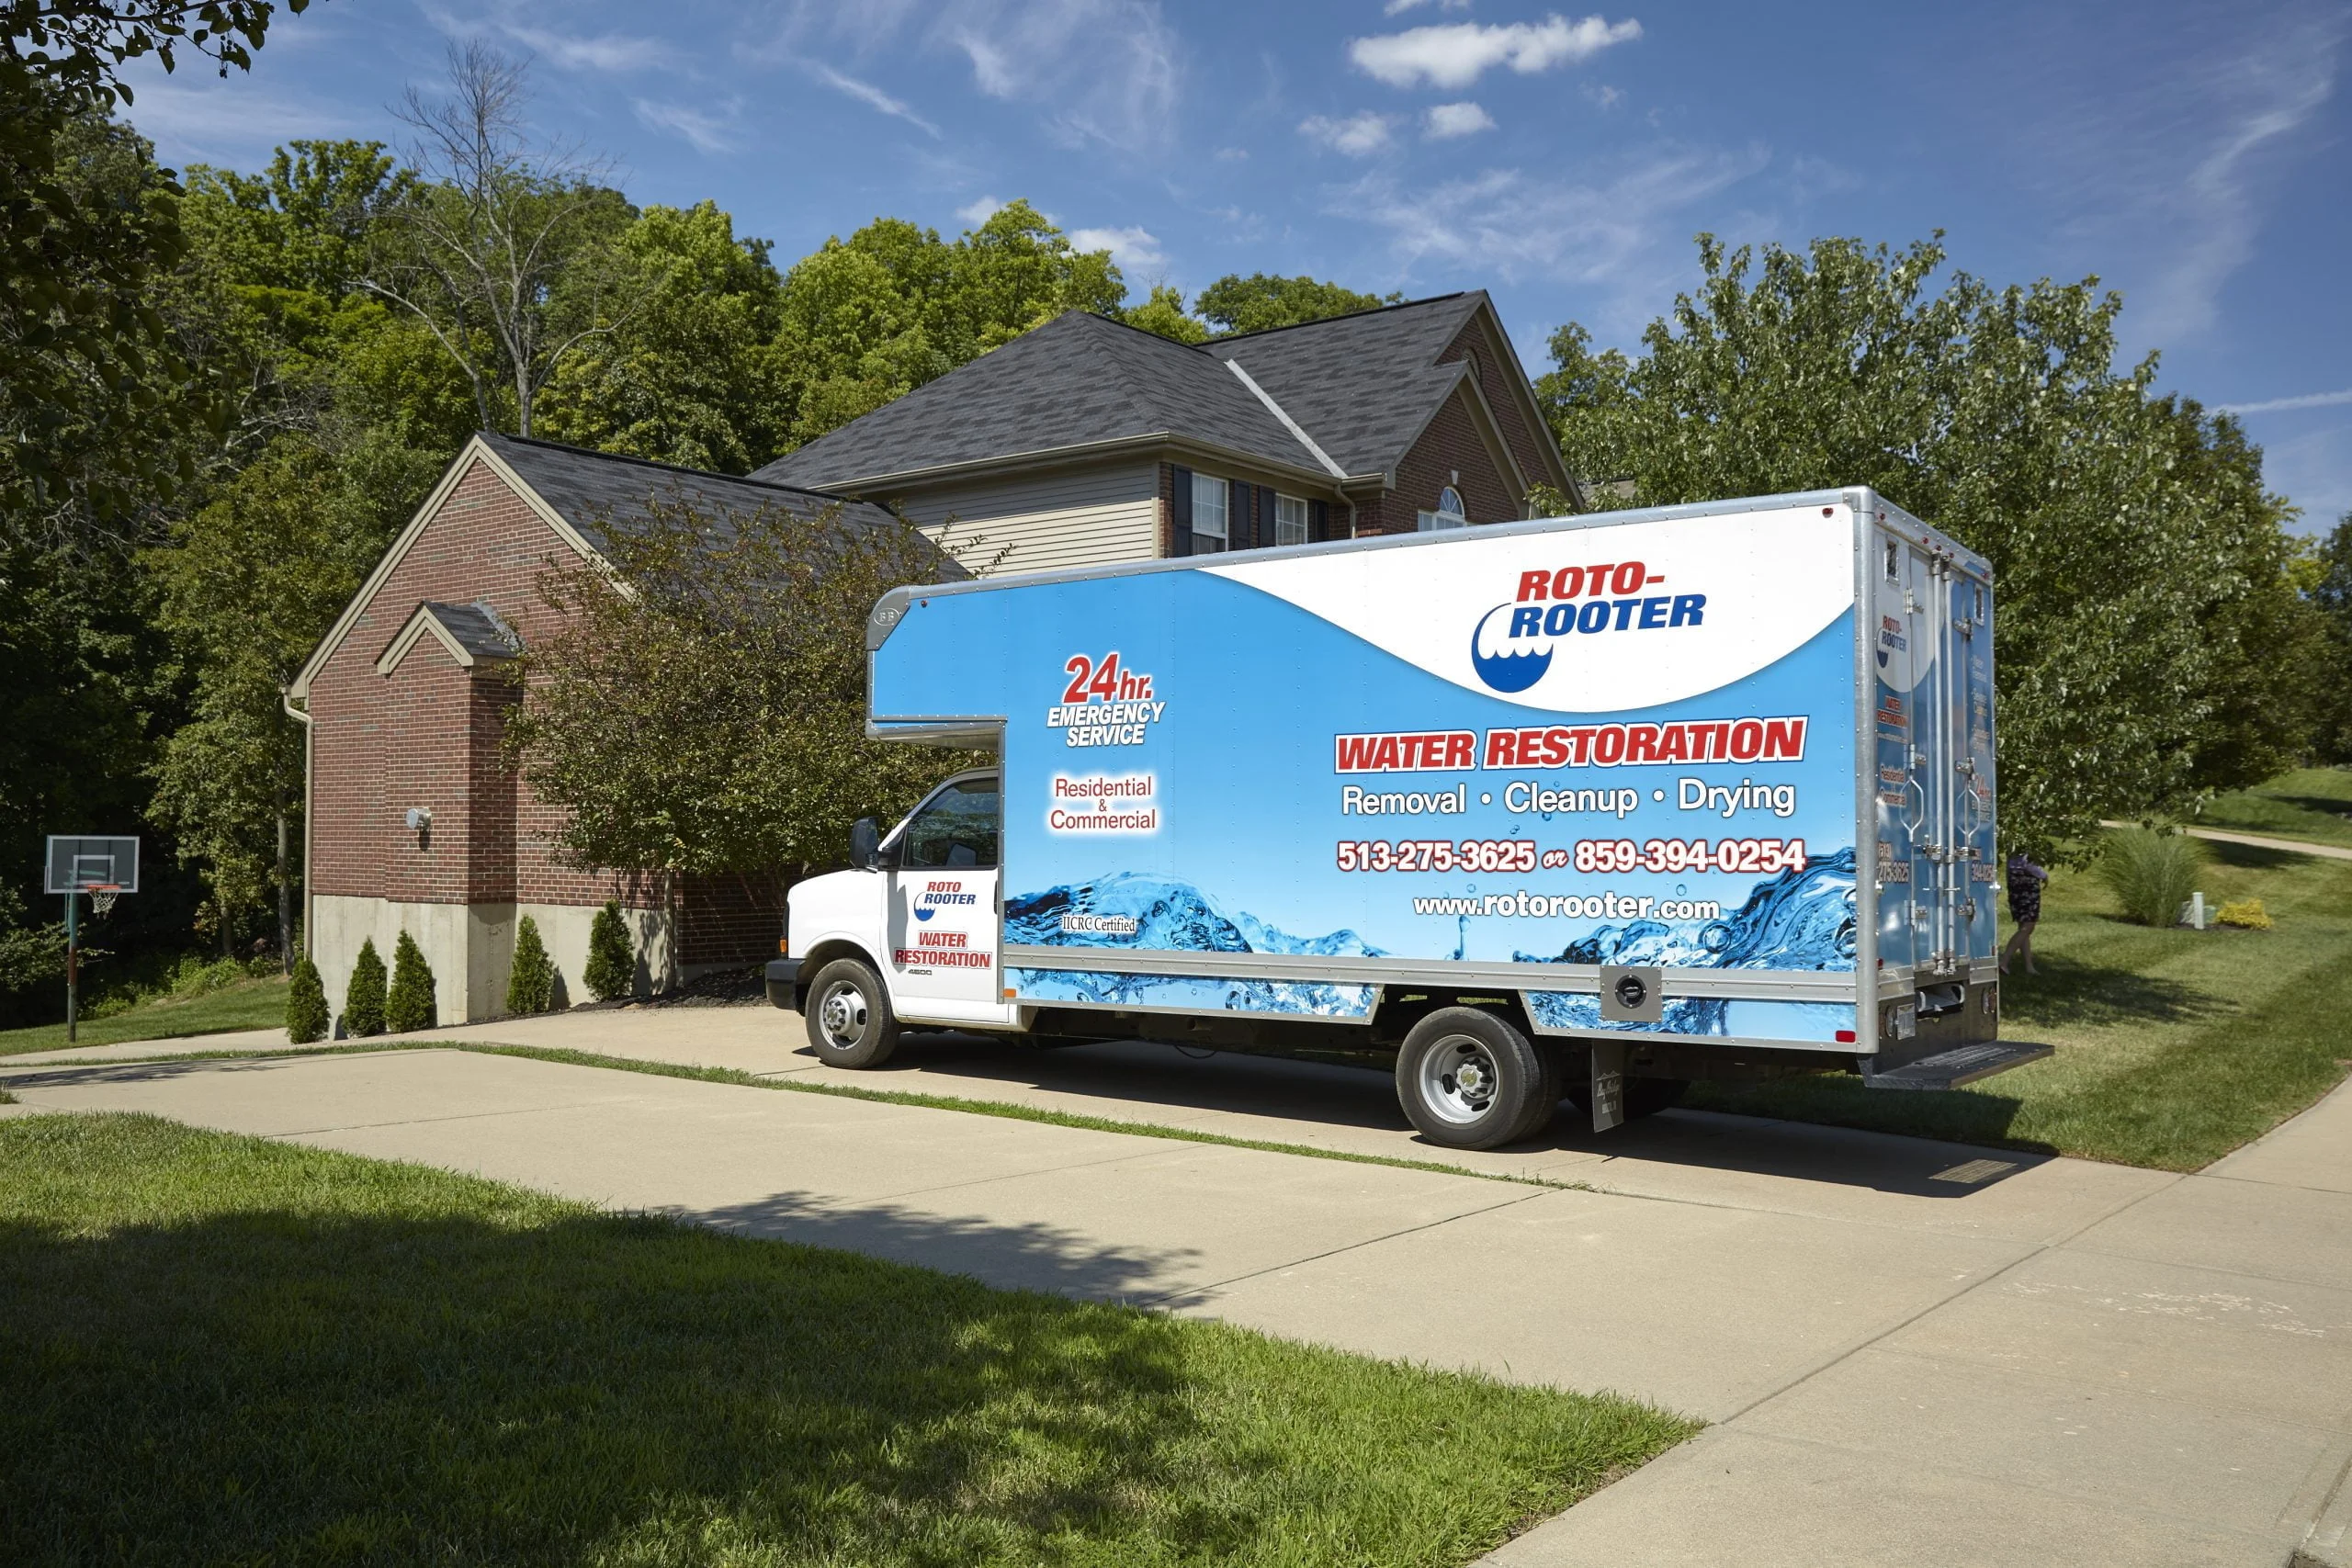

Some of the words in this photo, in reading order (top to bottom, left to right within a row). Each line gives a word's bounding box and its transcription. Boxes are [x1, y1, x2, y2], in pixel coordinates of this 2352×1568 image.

[1516, 560, 1665, 602] ROTO-
[1509, 593, 1707, 638] ROOTER
[1881, 630, 1907, 653] ROOTER
[1046, 701, 1166, 728] EMERGENCY
[1066, 724, 1146, 747] SERVICE
[1337, 732, 1475, 773] WATER
[1485, 719, 1804, 768] RESTORATION
[1056, 776, 1151, 797] Residential
[1098, 798, 1108, 812] &
[1341, 784, 1466, 816] Removal
[1504, 783, 1638, 818] Cleanup
[1678, 778, 1796, 818] Drying
[1050, 809, 1156, 829] Commercial
[1337, 840, 1536, 874] 513-275-3625
[1542, 849, 1568, 870] or
[1575, 838, 1807, 874] 859-394-0254
[1879, 862, 1909, 883] 275-3625
[926, 881, 962, 893] ROTO
[924, 893, 976, 905] ROOTER
[1413, 890, 1721, 920] www.rotorooter.com
[1063, 916, 1092, 931] IICRC
[1094, 917, 1135, 932] Certified
[919, 931, 967, 948] WATER
[895, 949, 991, 968] RESTORATION
